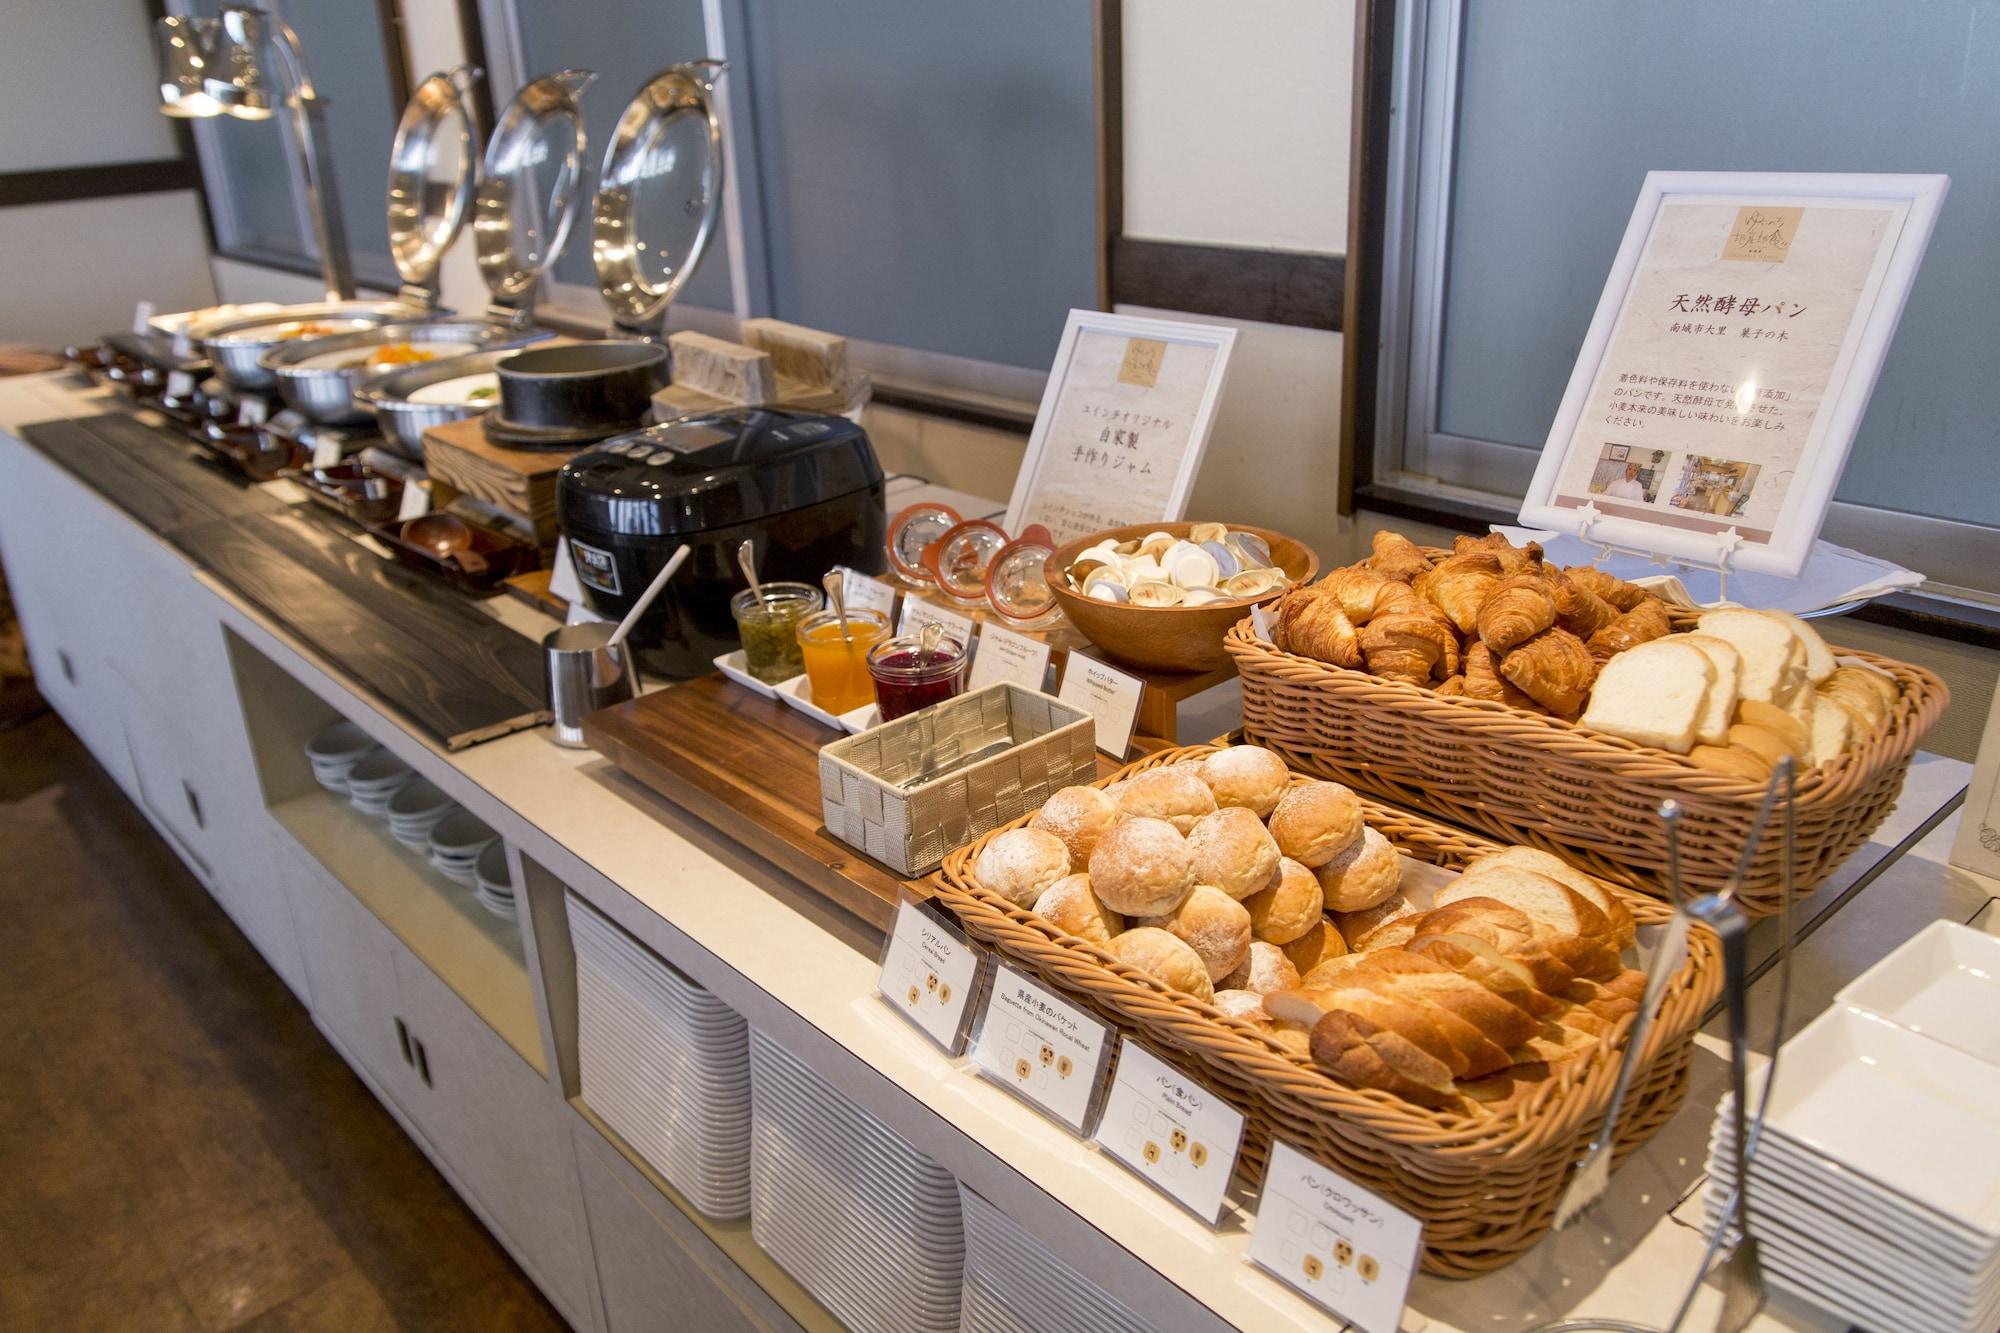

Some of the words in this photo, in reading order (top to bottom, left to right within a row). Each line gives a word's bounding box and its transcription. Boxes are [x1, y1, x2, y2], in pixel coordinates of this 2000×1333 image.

[1668, 293, 1808, 318] 天然酵母パン
[1669, 322, 1728, 336] 南城市大里
[1740, 327, 1790, 342] 菓子の木
[1604, 415, 1646, 429] ください。
[1099, 426, 1140, 450] 自家製
[1071, 445, 1152, 474] 手作りジャム
[921, 927, 952, 956] シリアルパン
[1000, 992, 1023, 1010] Baguette
[1022, 1005, 1035, 1018] from
[1034, 1012, 1059, 1033] Okinawan
[1073, 1037, 1090, 1053] Wheat
